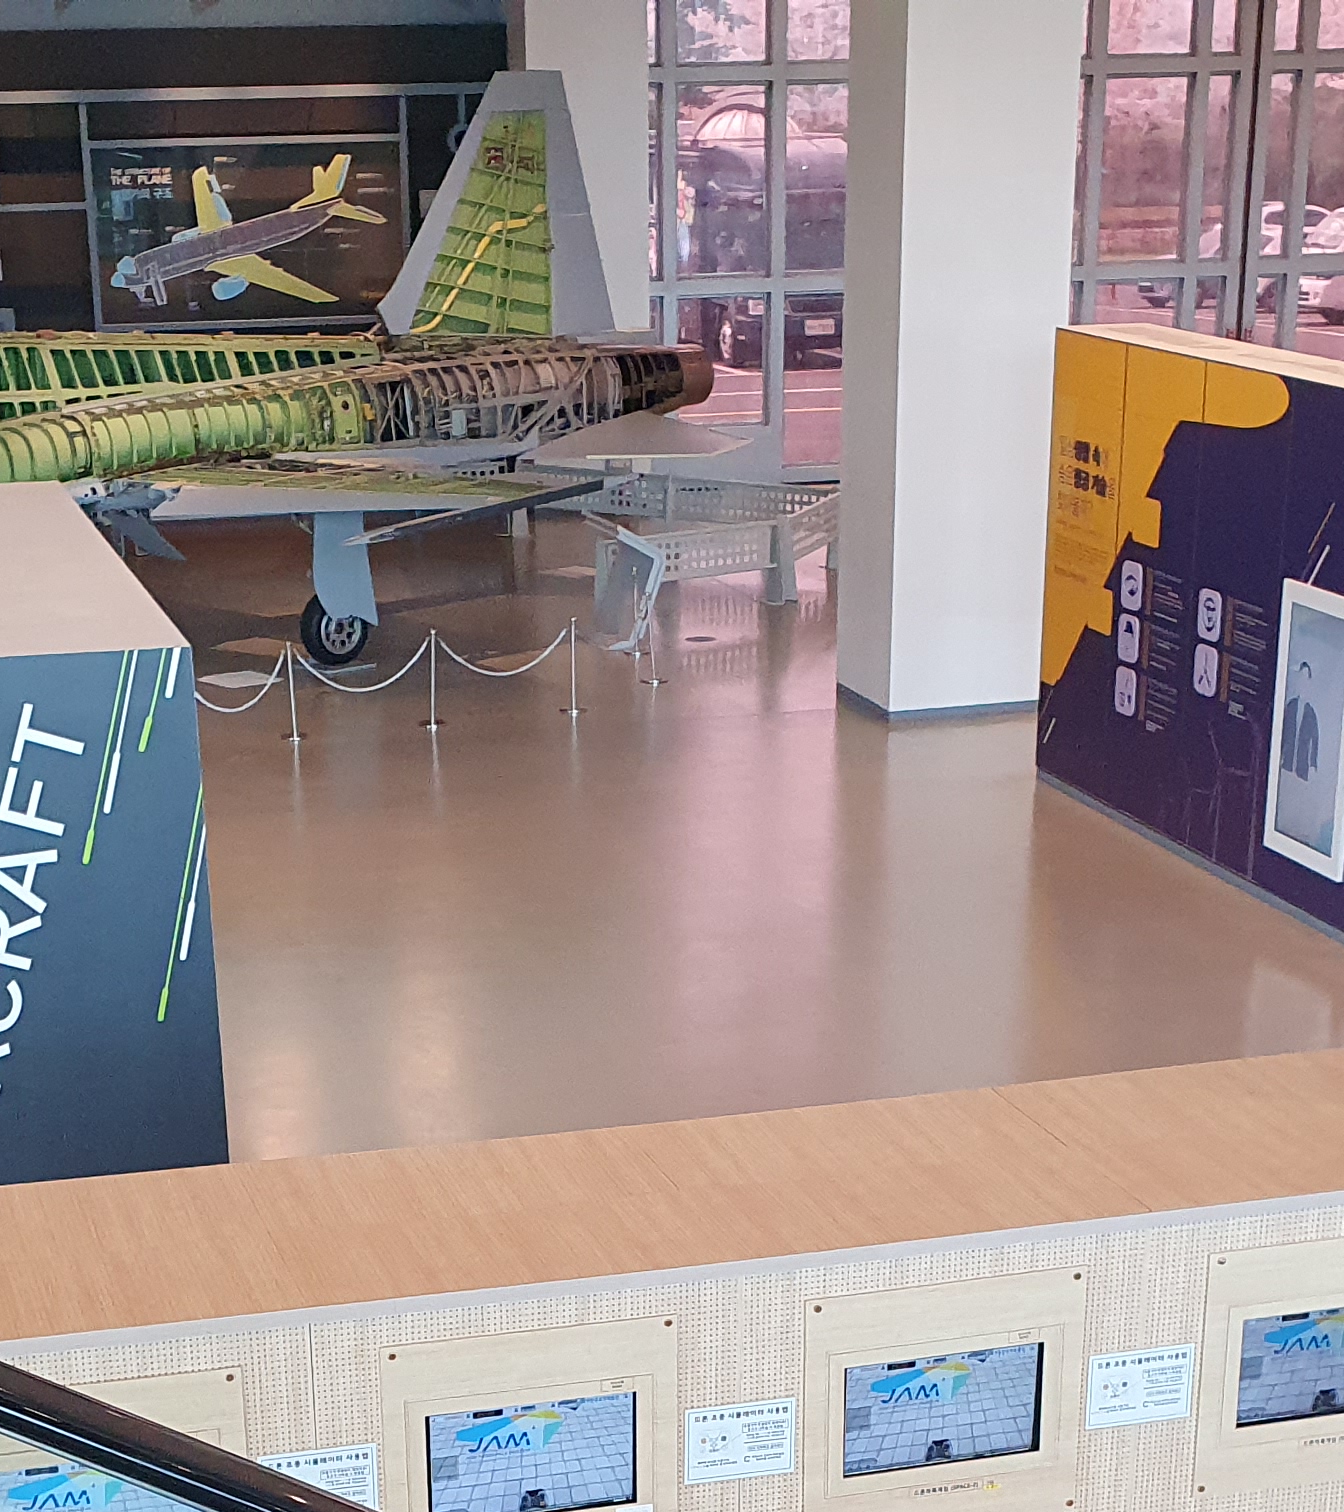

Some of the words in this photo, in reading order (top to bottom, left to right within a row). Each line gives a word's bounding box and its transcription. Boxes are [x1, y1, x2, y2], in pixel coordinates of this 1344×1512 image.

[110, 175, 133, 186] THE
[137, 174, 174, 185] PLANE
[1274, 1334, 1331, 1355] JAM
[881, 1383, 940, 1404] JAM
[468, 1431, 531, 1453] JAM
[22, 1489, 91, 1512] JAM
